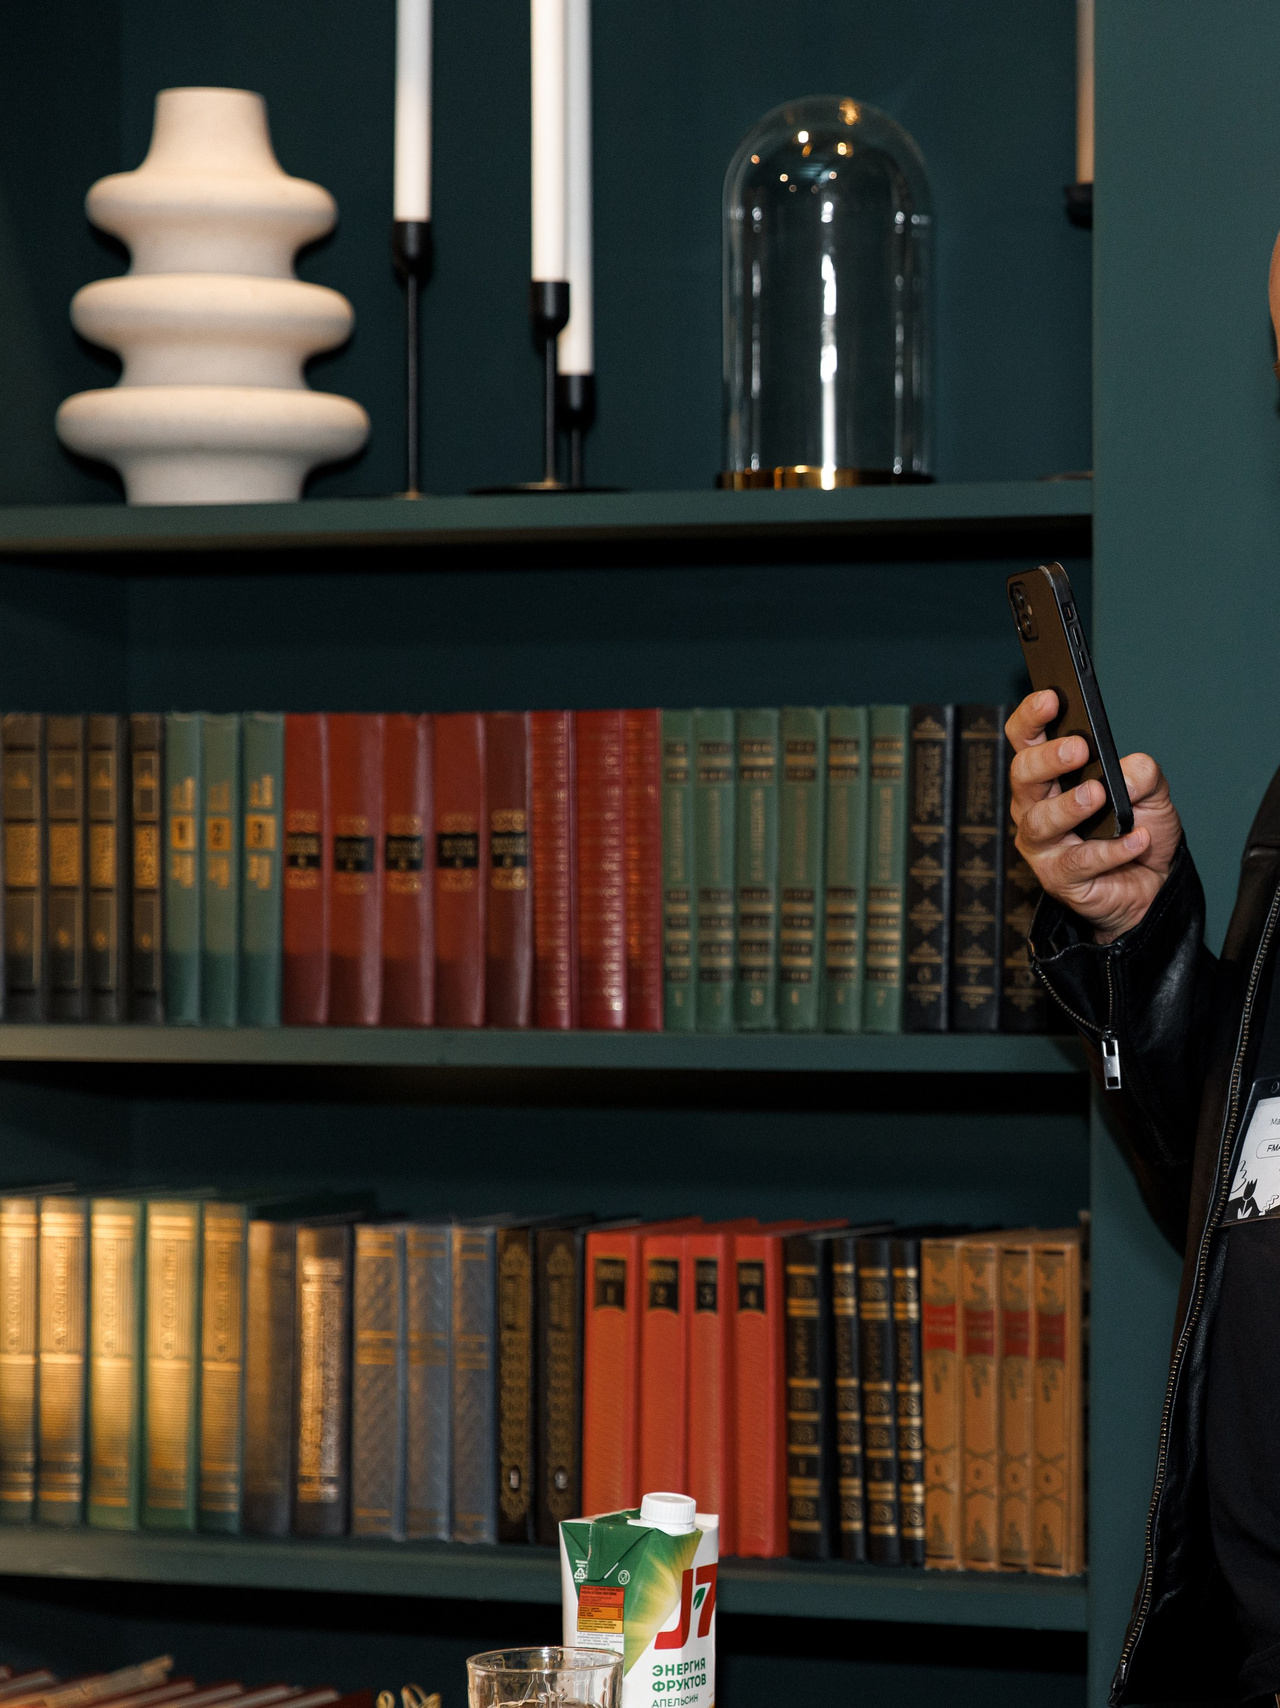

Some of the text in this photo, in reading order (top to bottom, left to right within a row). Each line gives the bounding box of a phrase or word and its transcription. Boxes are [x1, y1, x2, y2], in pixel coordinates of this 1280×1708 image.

[654, 1562, 718, 1650] J7
[652, 1656, 706, 1677] ЭНЕРГИЯ
[652, 1673, 707, 1693] ФРУКТОВ
[651, 1693, 699, 1708] АПЕЛЬСИН
